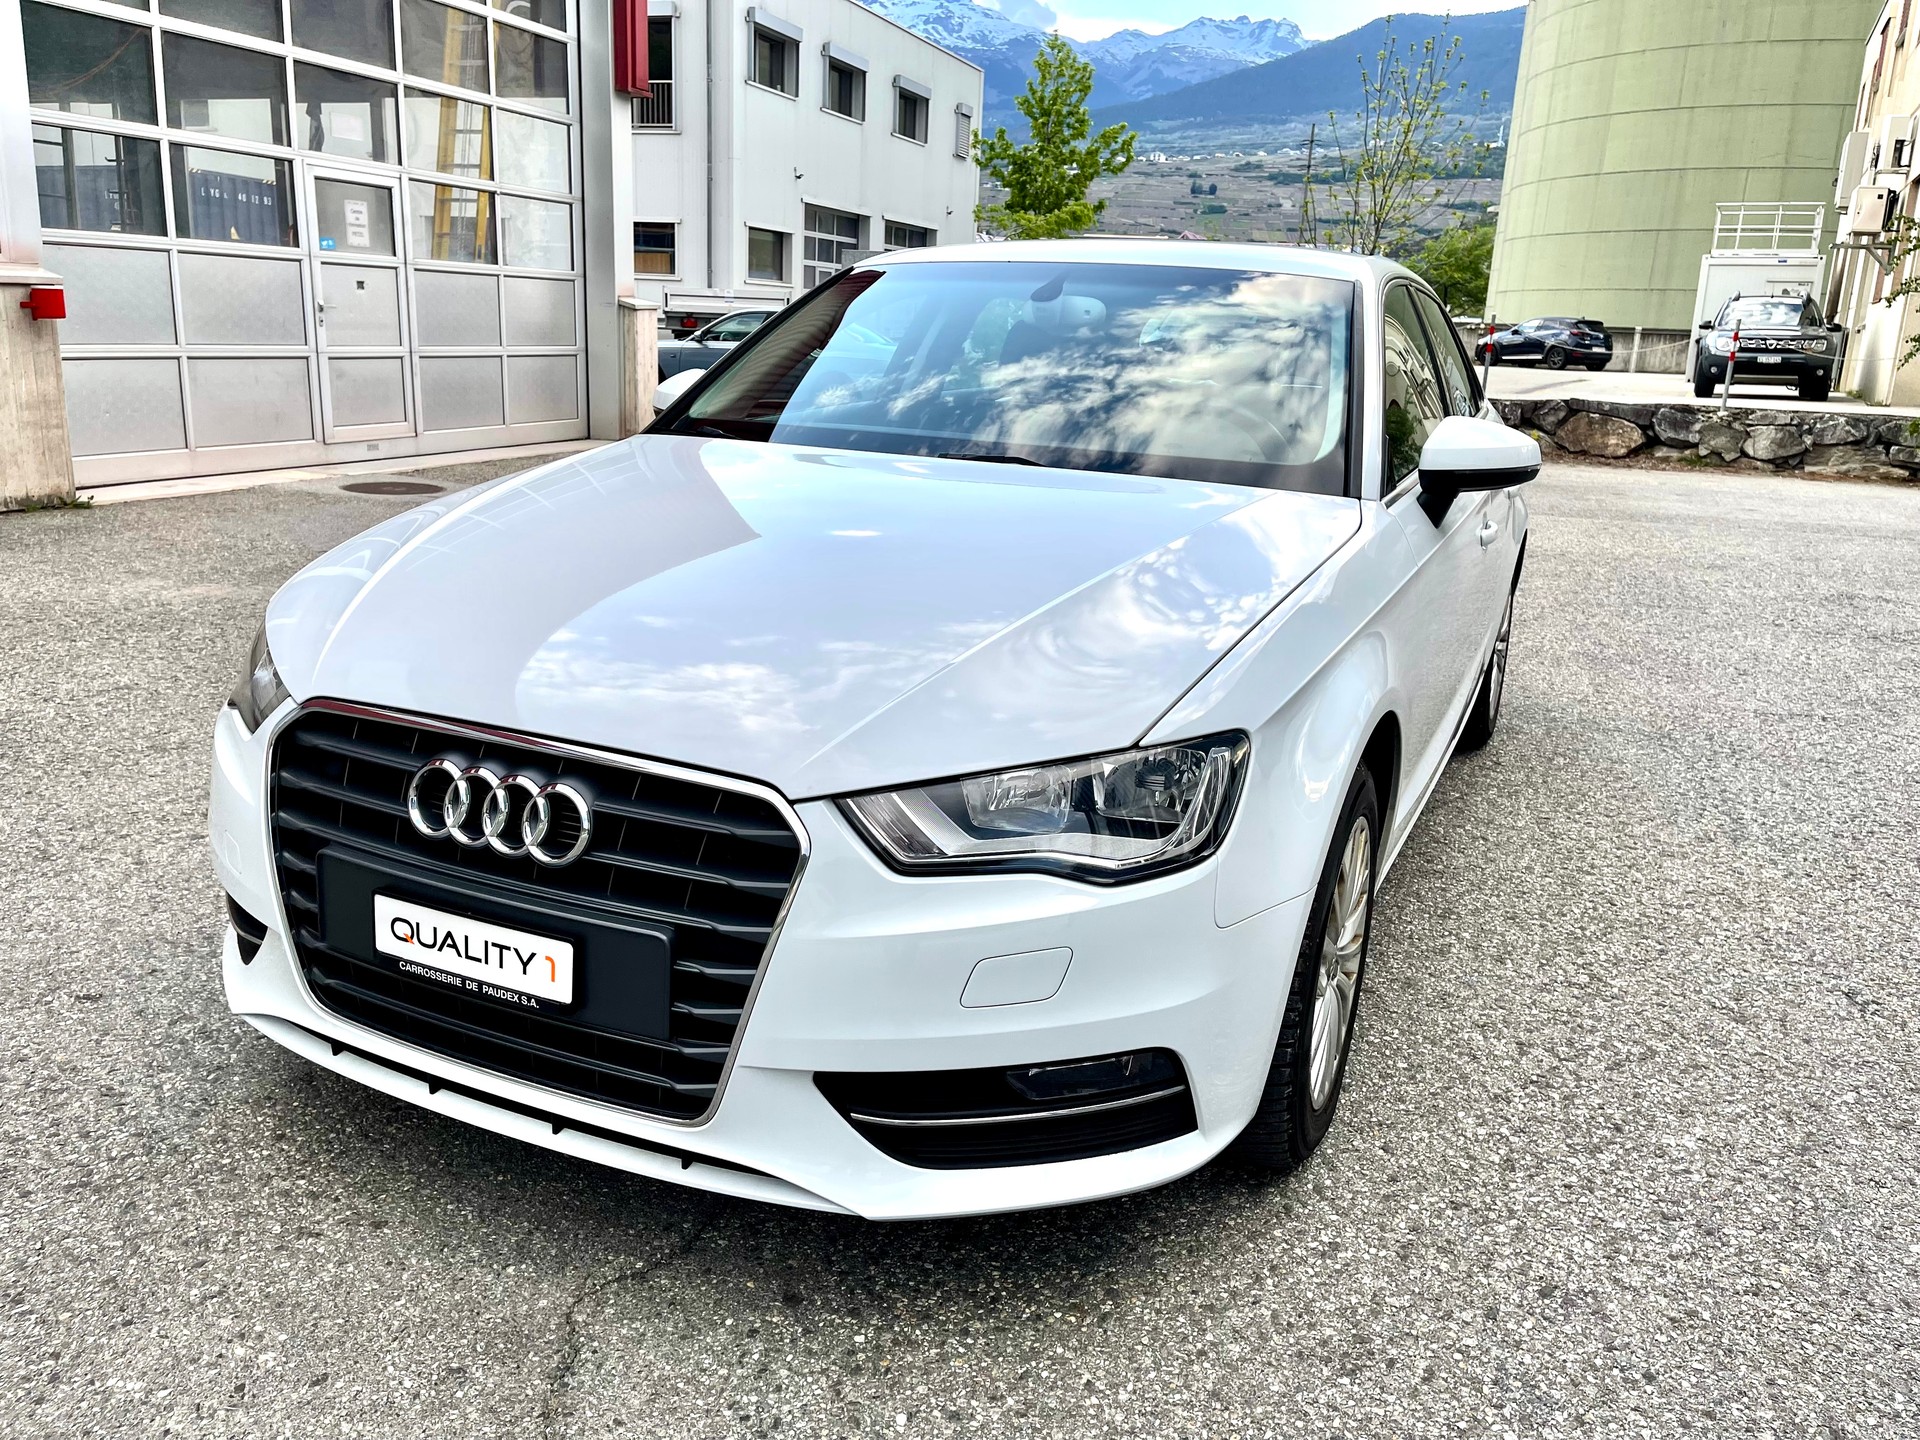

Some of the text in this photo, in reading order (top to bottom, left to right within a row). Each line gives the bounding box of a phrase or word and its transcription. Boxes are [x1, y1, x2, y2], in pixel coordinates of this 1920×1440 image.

[390, 916, 556, 983] QUALITY 1
[399, 961, 540, 1009] CARROSSERIE DE PAUDEX S.A.
